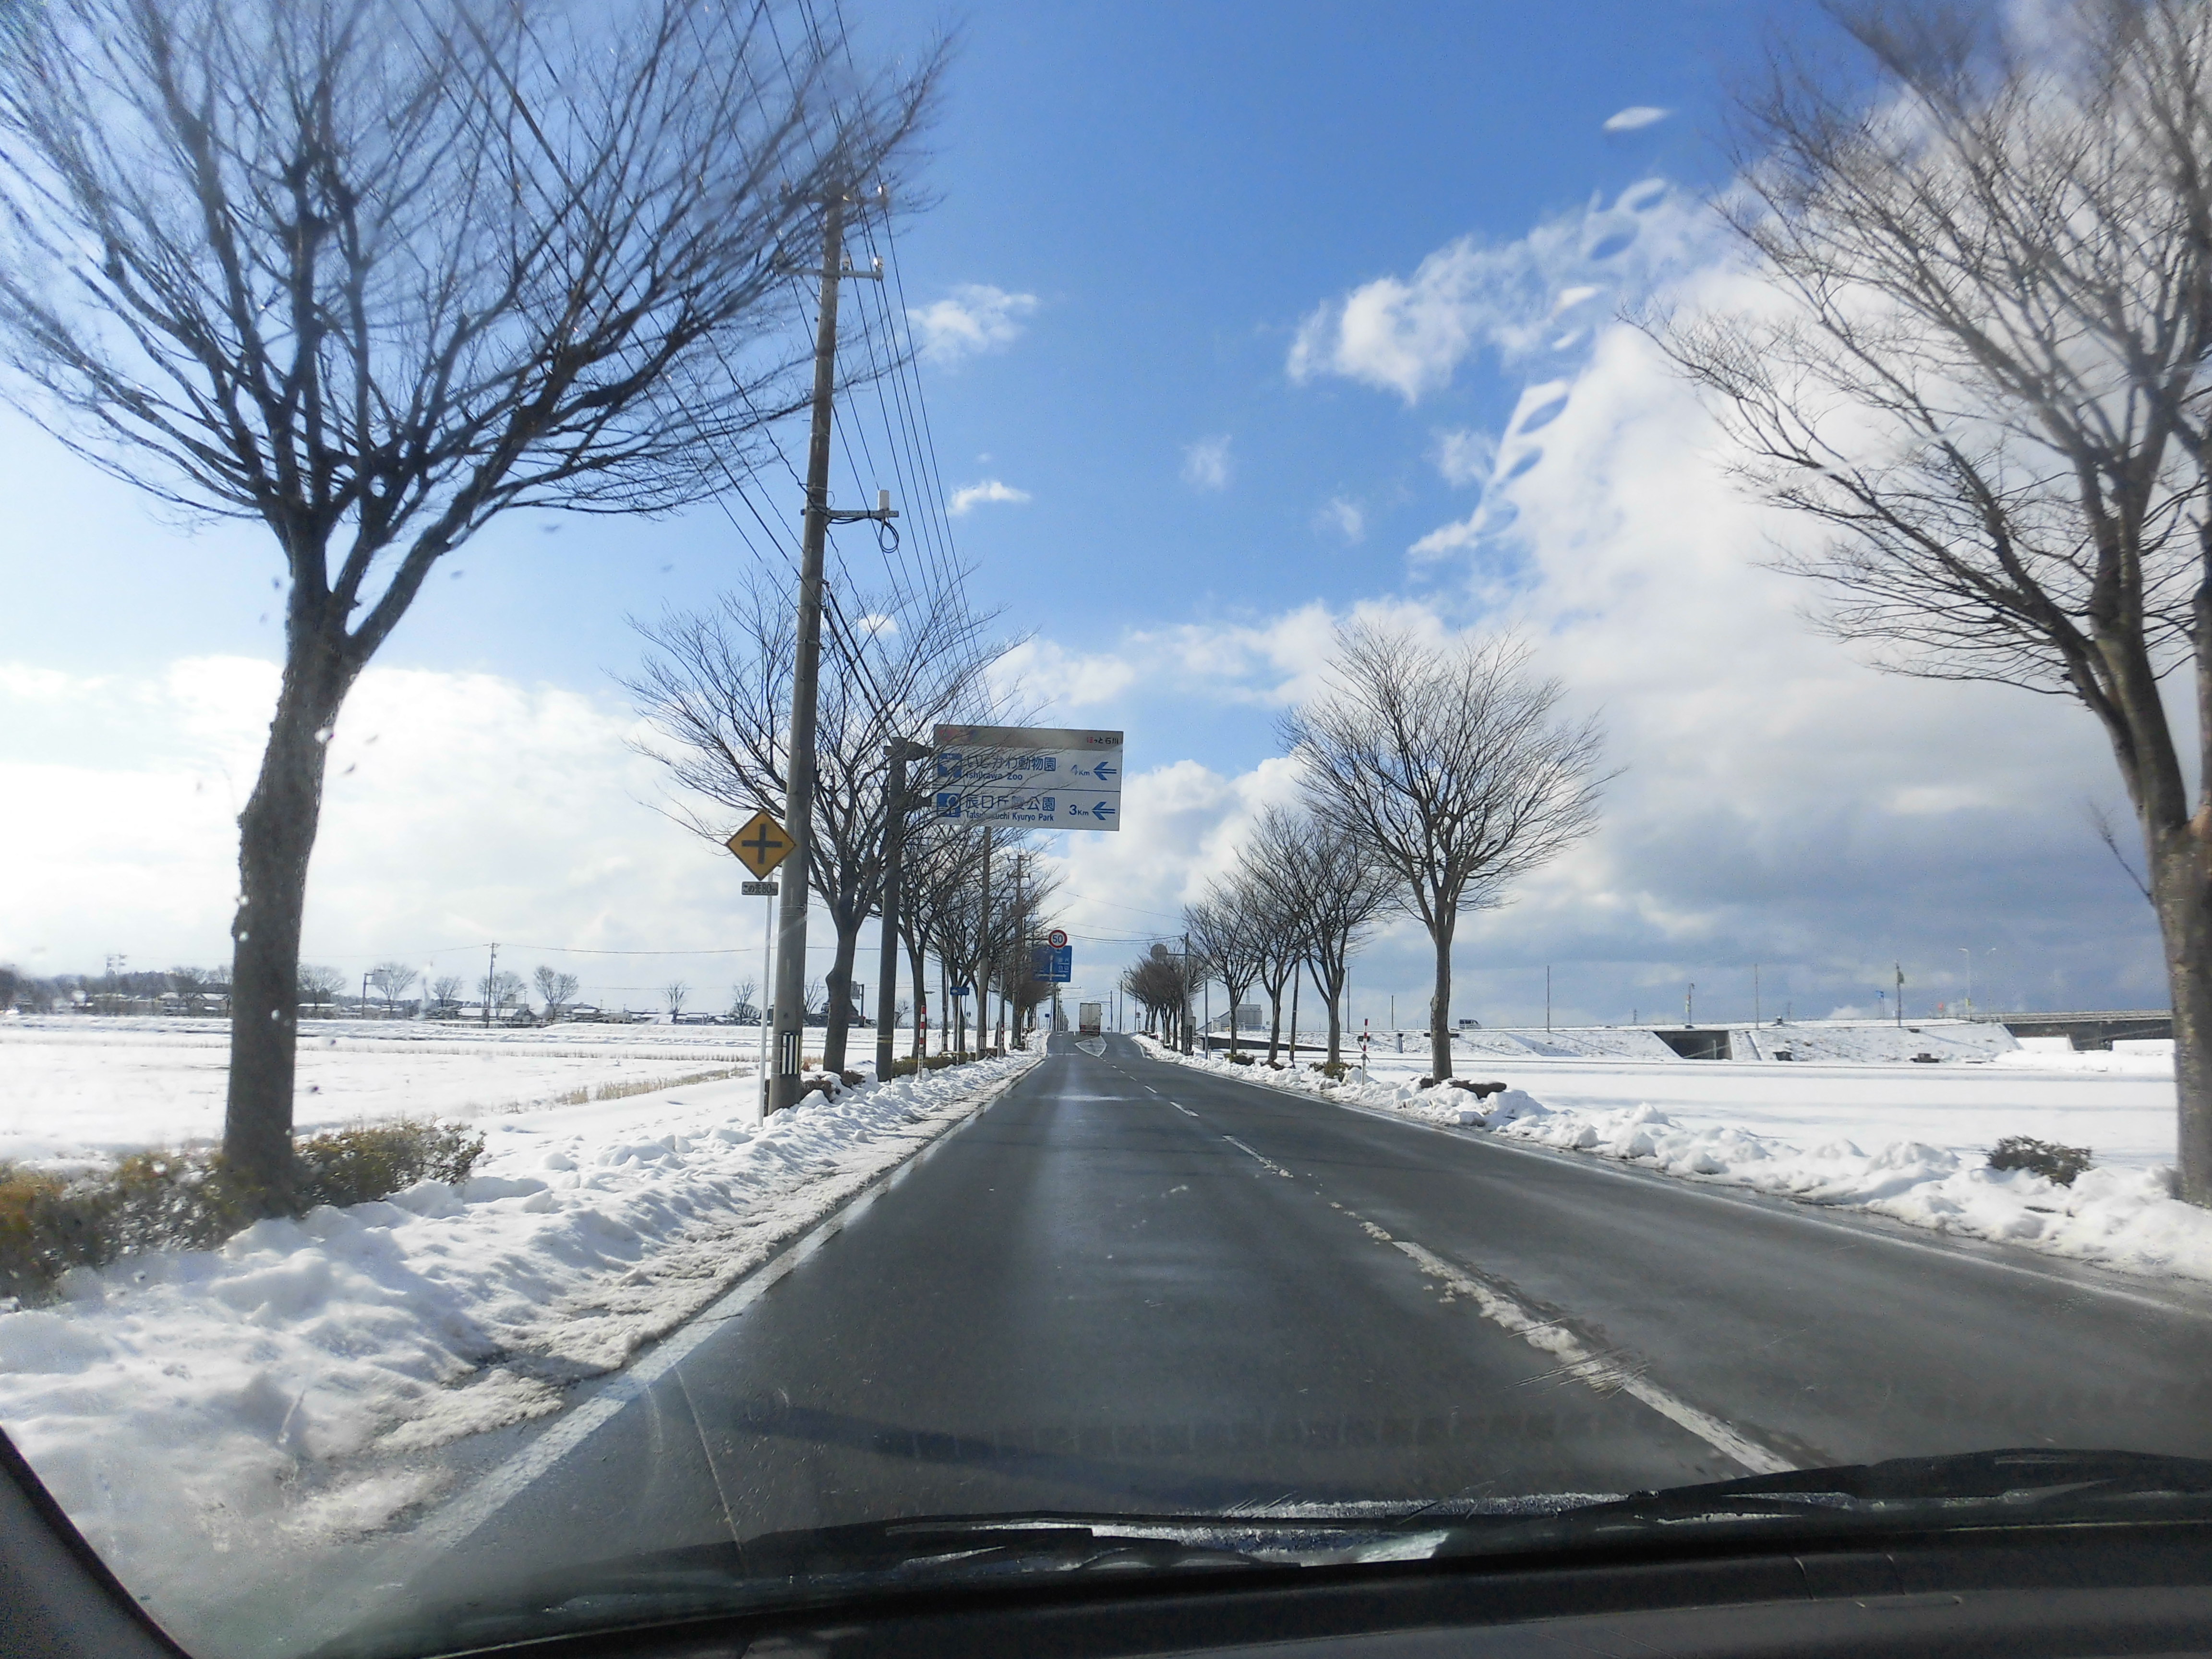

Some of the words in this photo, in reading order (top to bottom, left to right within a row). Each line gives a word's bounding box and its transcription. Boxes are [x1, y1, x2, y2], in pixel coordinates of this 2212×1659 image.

[1007, 772, 1023, 781] Zoo
[1012, 813, 1035, 822] Kyuryo
[1038, 813, 1054, 821] Park
[1053, 935, 1063, 943] 50
